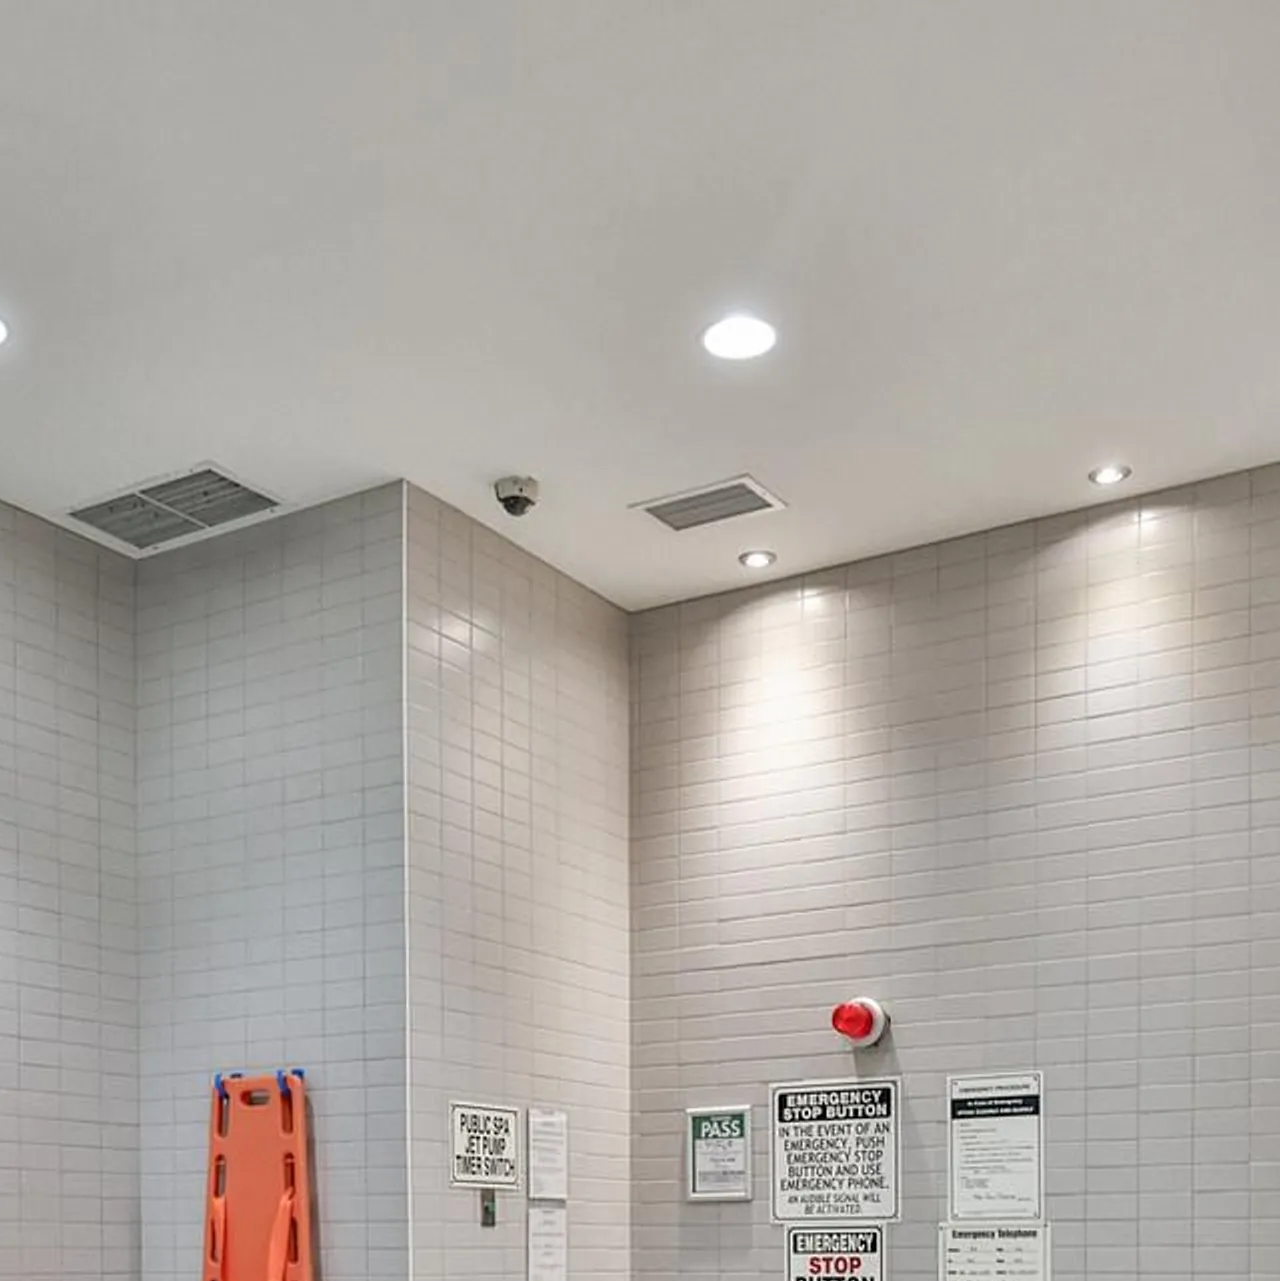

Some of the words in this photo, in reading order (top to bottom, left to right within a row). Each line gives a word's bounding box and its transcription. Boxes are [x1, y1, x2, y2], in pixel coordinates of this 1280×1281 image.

[786, 1090, 882, 1107] EMERGENCY
[783, 1107, 823, 1120] STOP
[825, 1104, 888, 1119] BUTTON
[460, 1113, 491, 1135] PUBLIC
[493, 1116, 510, 1136] SPA
[701, 1120, 741, 1137] PASS
[778, 1126, 790, 1137] IN
[792, 1125, 814, 1137] THE
[817, 1124, 853, 1137] EVENT
[855, 1122, 870, 1135] OF
[874, 1121, 891, 1134] AN
[465, 1135, 480, 1153] JET
[483, 1136, 505, 1155] PUMP
[855, 1136, 885, 1149] PUSH
[786, 1150, 850, 1164] EMERGENCY
[854, 1150, 884, 1162] STOP
[456, 1155, 482, 1175] TIMER
[484, 1156, 515, 1177] SWITCH
[788, 1165, 834, 1178] BUTTON
[835, 1164, 859, 1176] AND
[861, 1162, 882, 1175] USE
[780, 1178, 844, 1191] EMERGENCY
[797, 1234, 873, 1251] EMERGENCY
[809, 1257, 861, 1274] STOP
